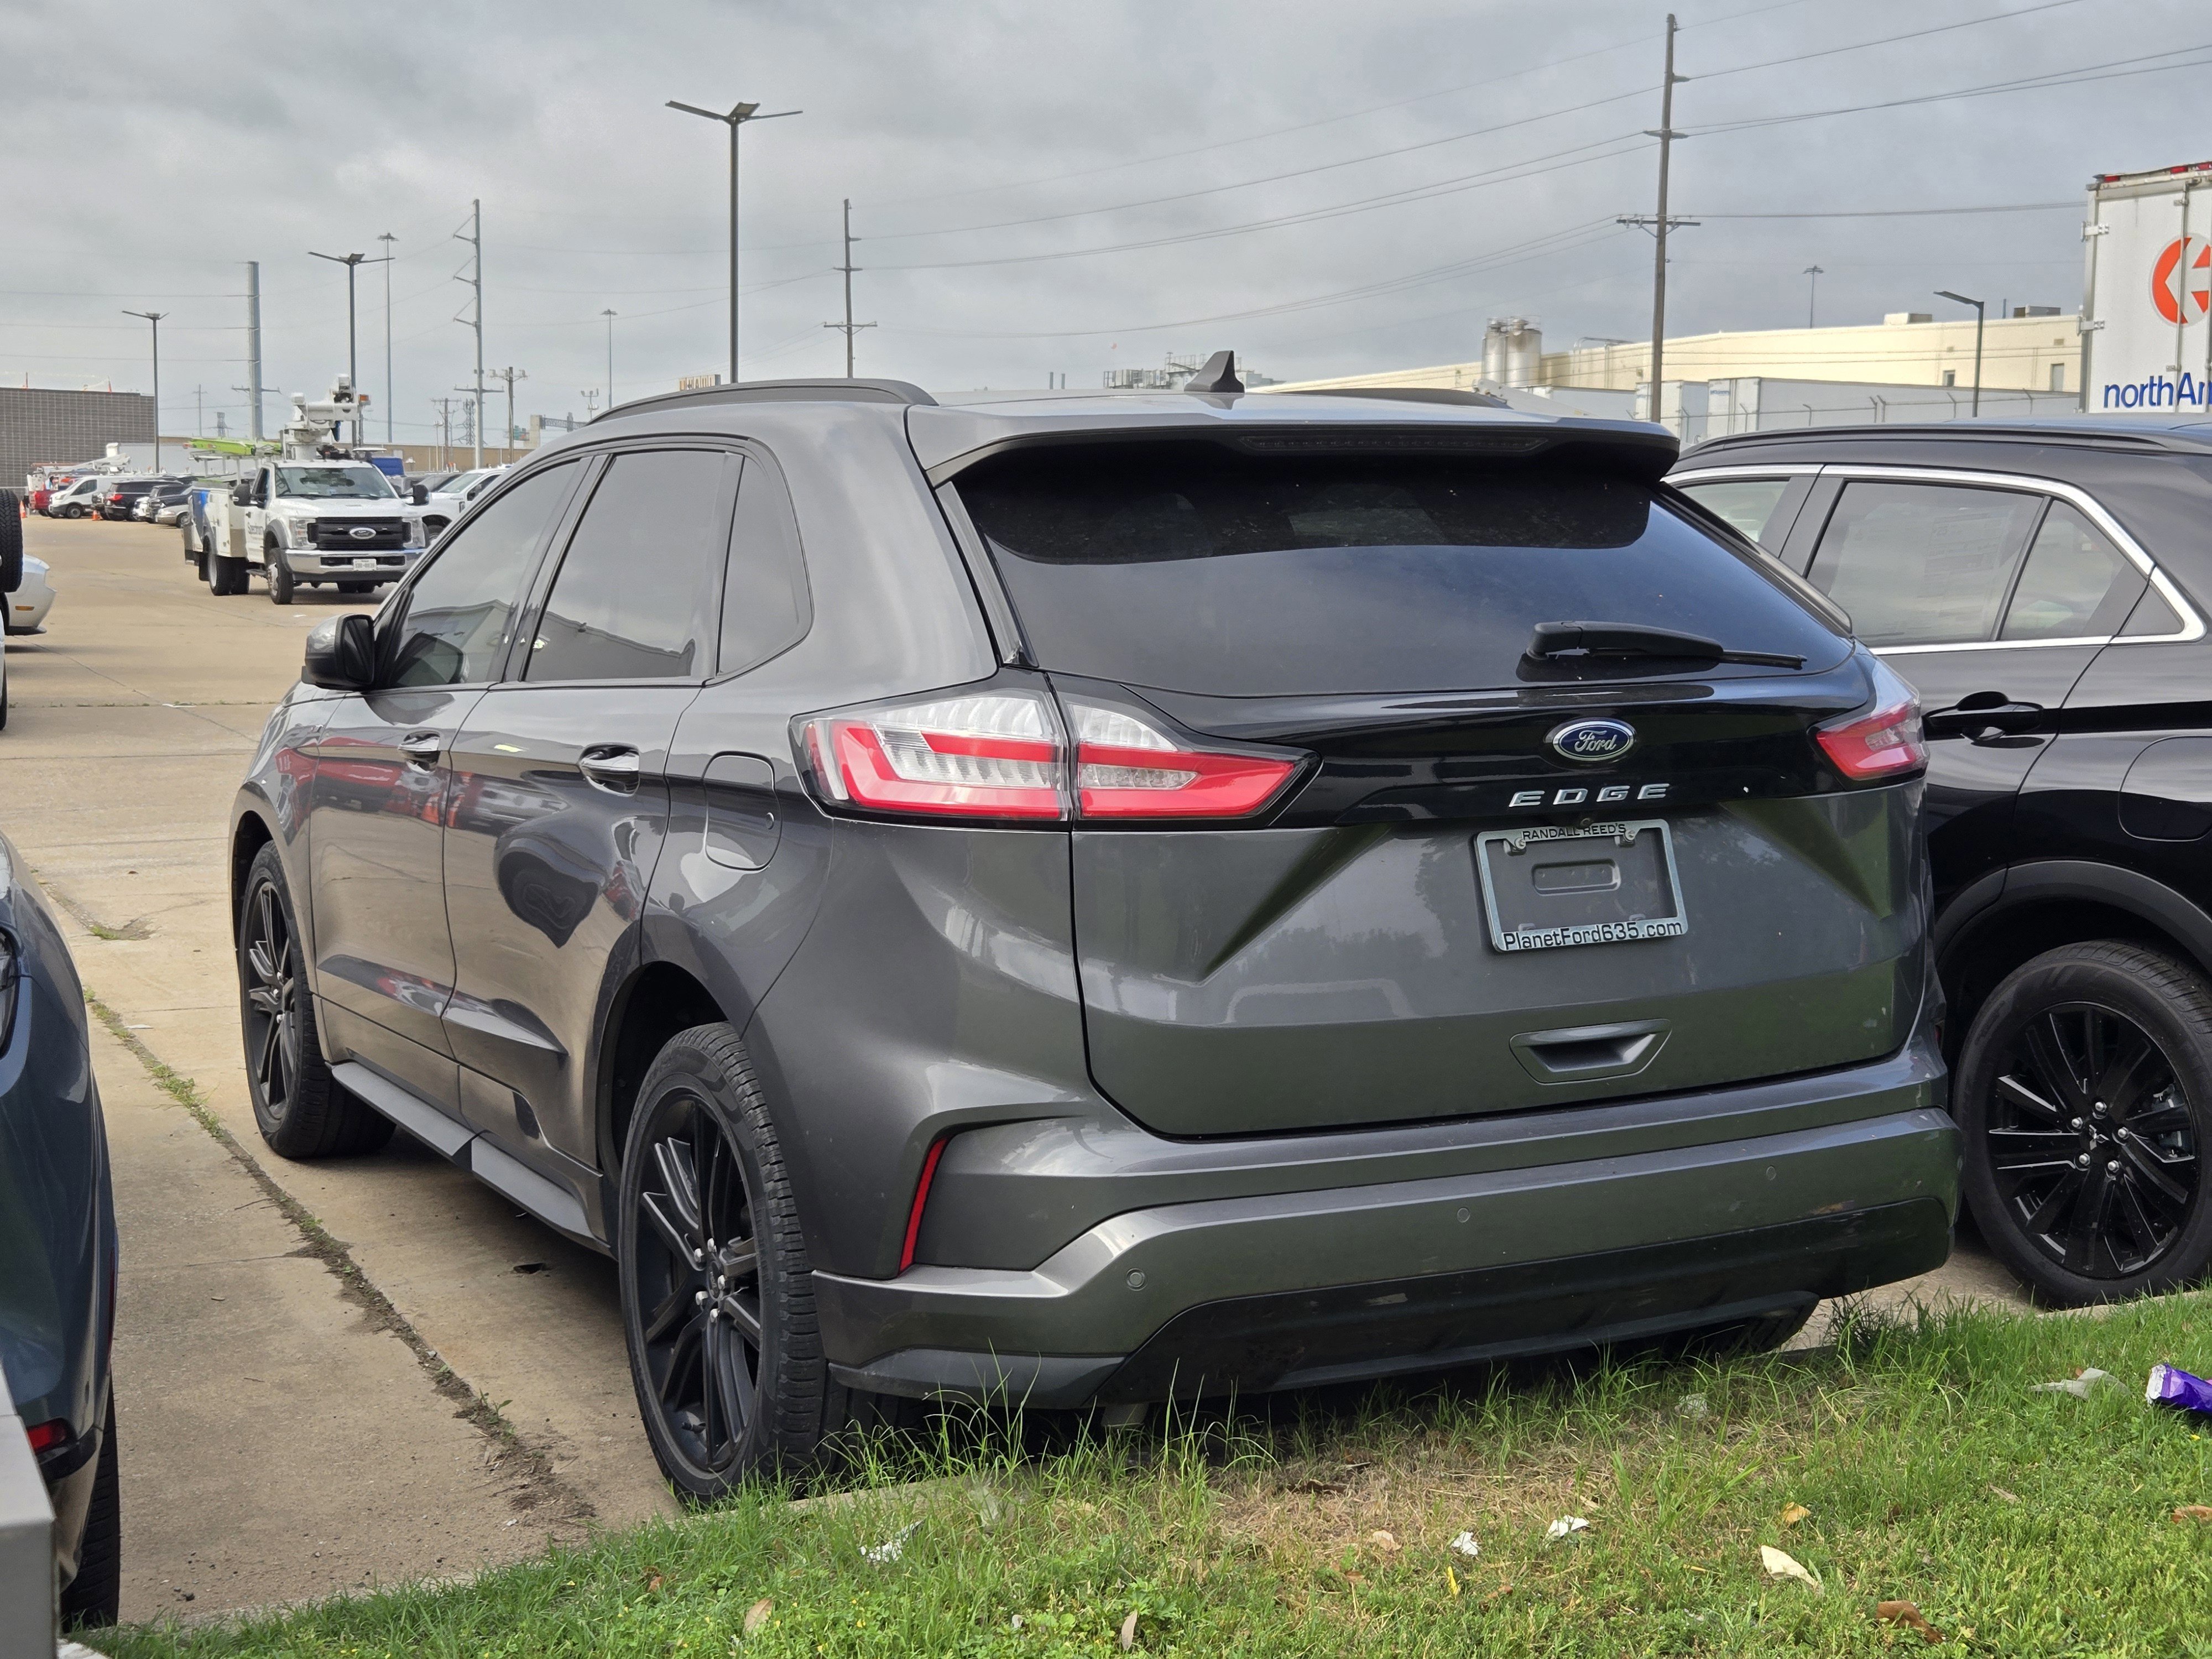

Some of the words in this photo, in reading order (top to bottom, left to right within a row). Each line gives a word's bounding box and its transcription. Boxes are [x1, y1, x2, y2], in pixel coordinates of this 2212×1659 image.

[1574, 729, 1617, 752] Ford
[1509, 783, 1670, 807] EDGE
[1522, 827, 1580, 840] RANDALL
[1583, 822, 1626, 835] REED'S
[1503, 921, 1683, 950] PlanetFord635.com
